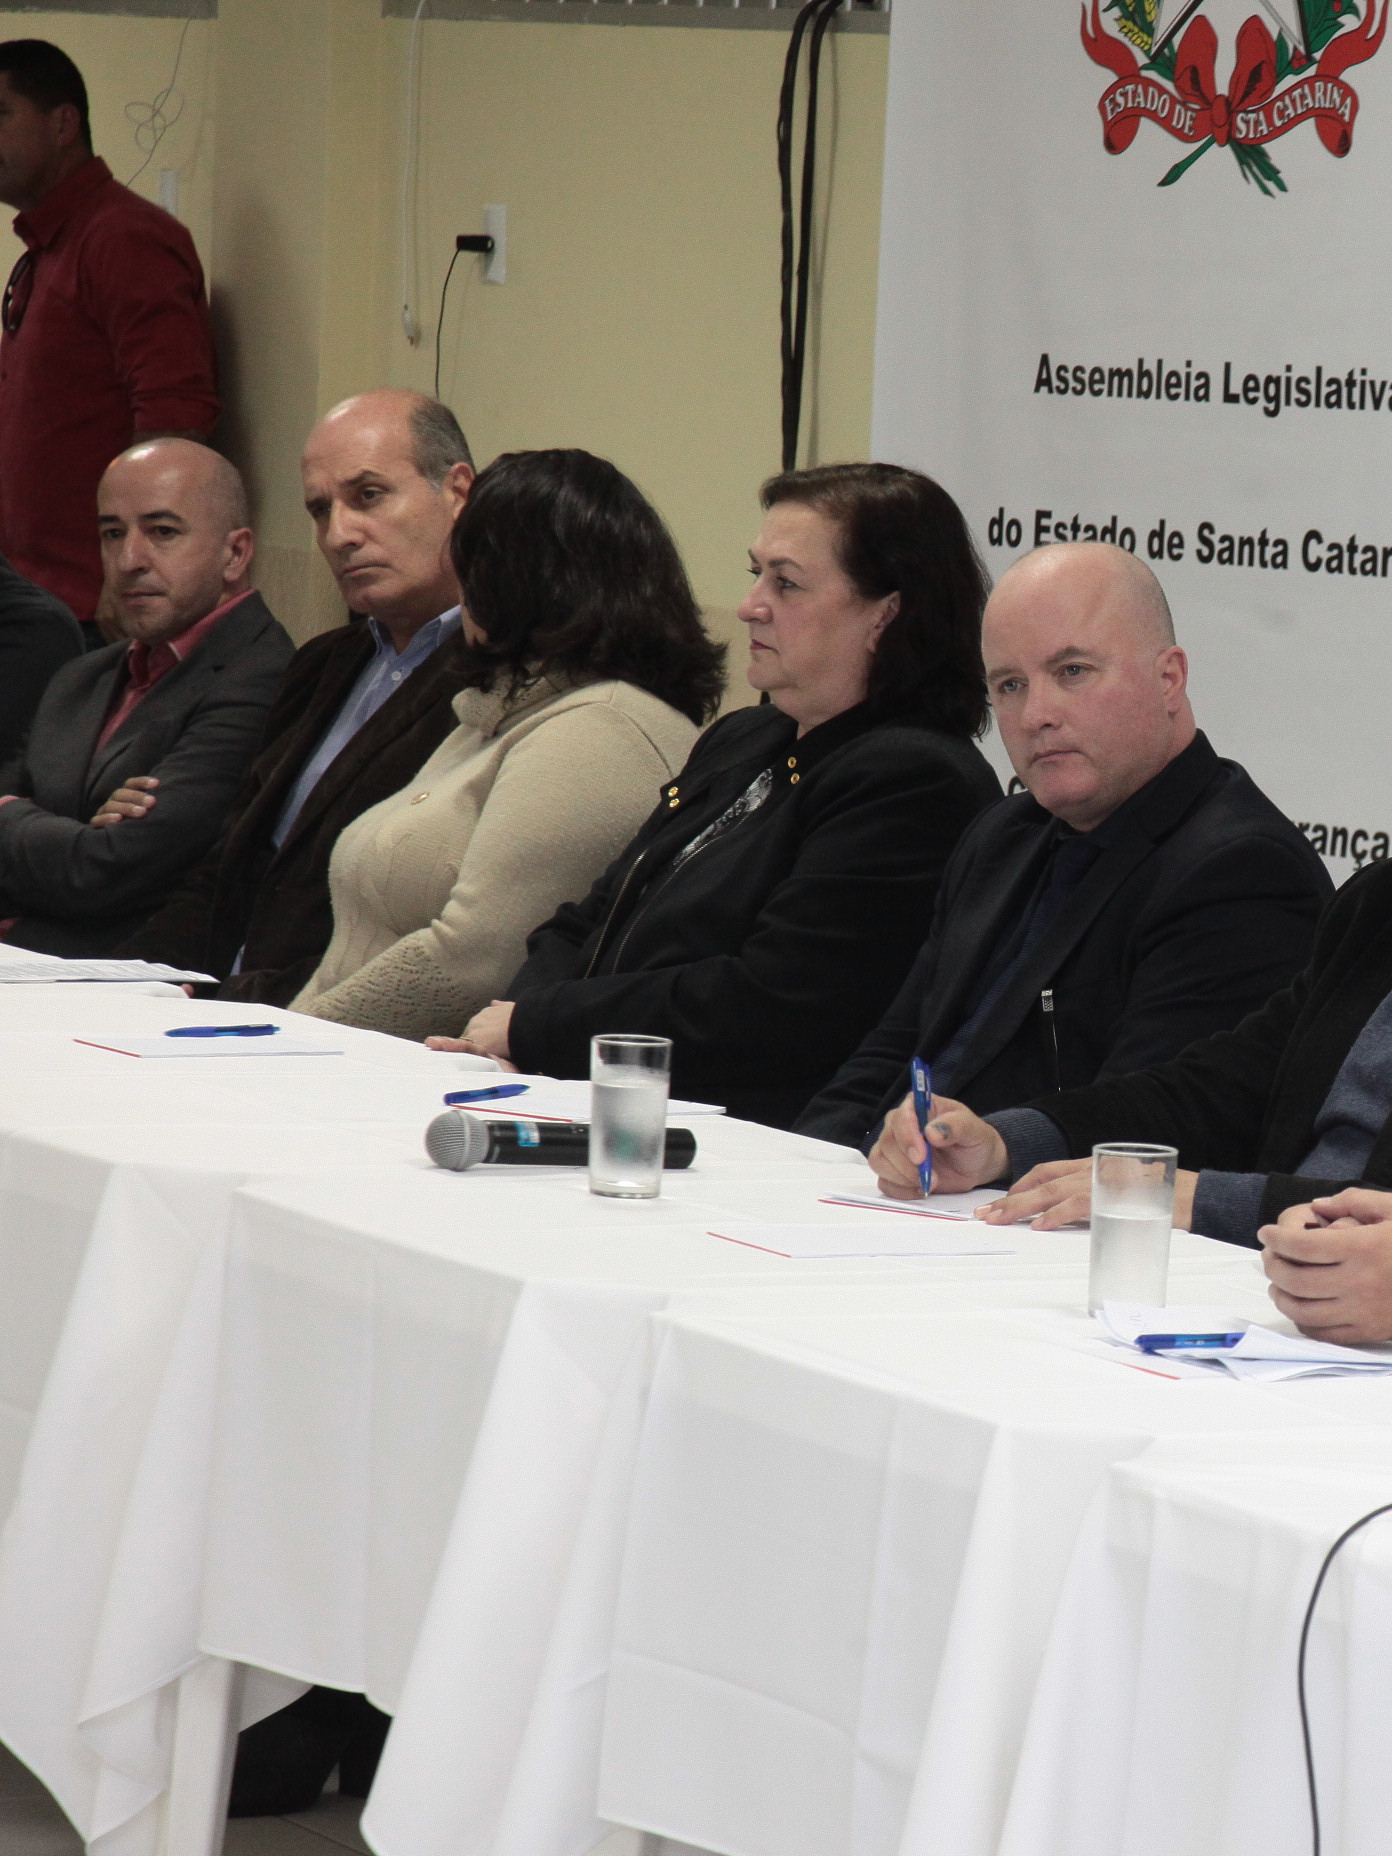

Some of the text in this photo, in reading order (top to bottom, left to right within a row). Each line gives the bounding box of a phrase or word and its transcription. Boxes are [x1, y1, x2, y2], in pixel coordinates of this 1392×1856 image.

[1104, 80, 1352, 140] ESTADO DE STA. CATARINA
[1033, 352, 1211, 403] Assembleia
[987, 506, 1023, 549] do
[1146, 518, 1185, 562] de
[1195, 521, 1289, 570] Santa
[1297, 821, 1390, 871] rança
